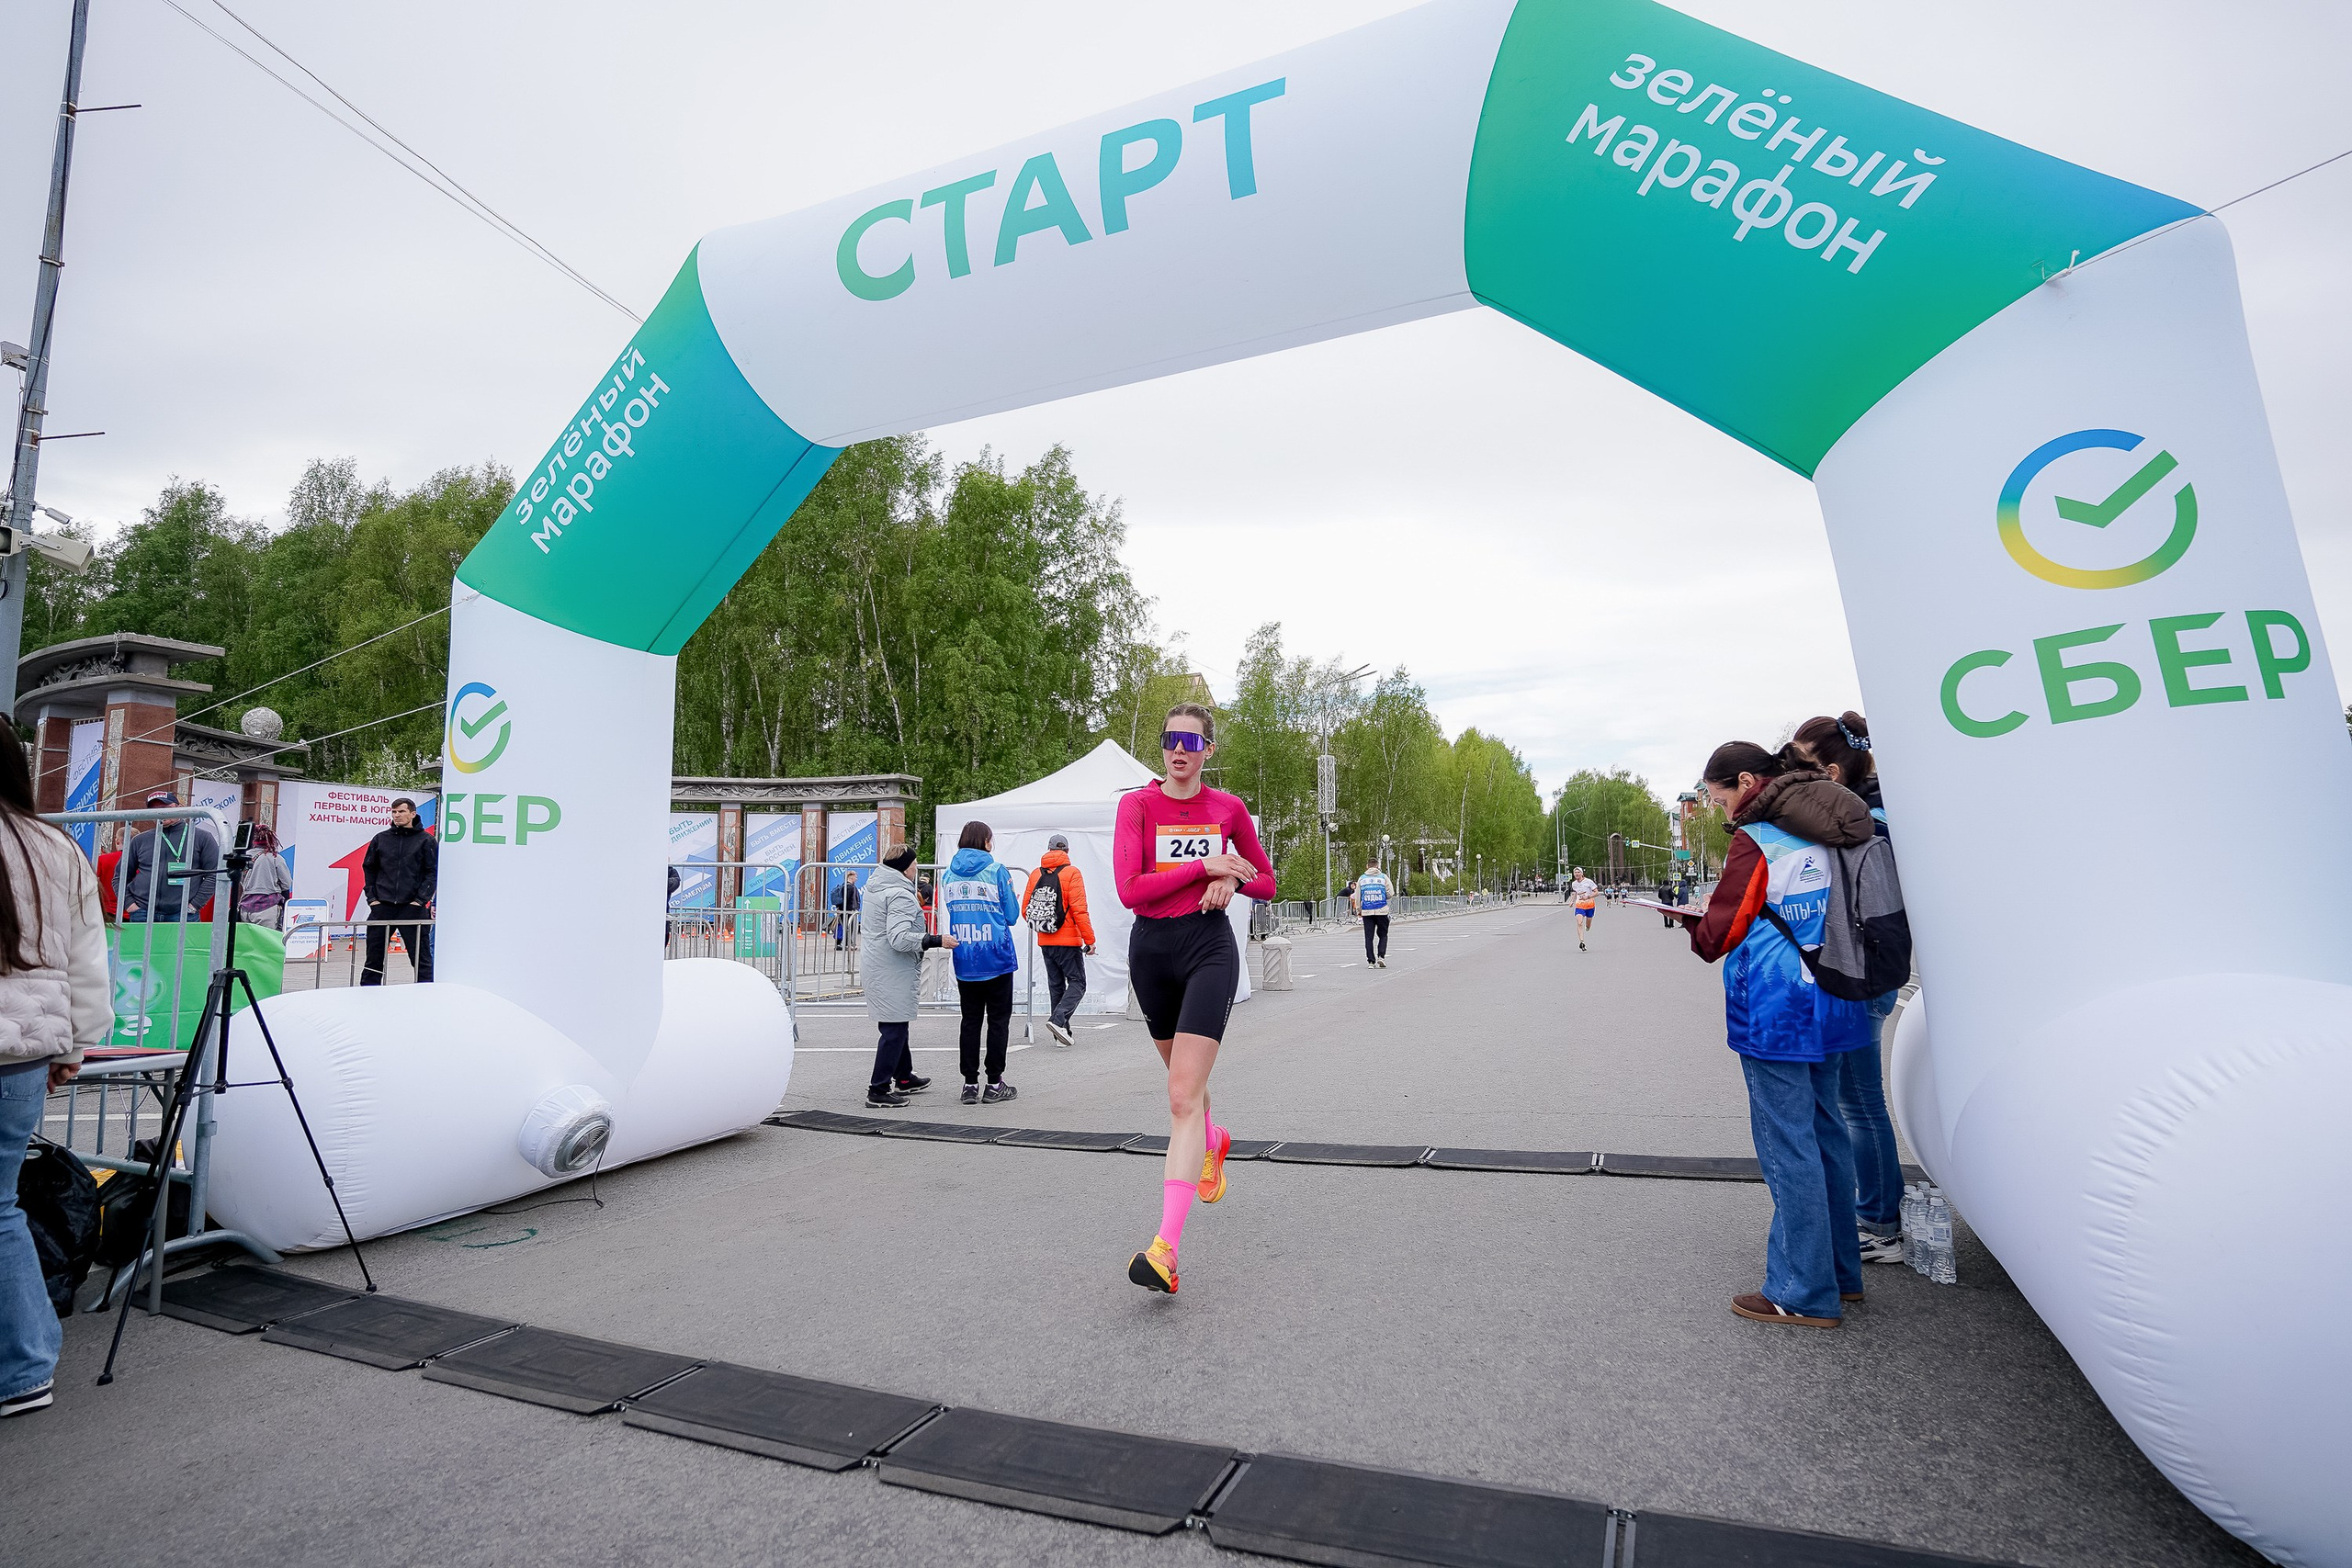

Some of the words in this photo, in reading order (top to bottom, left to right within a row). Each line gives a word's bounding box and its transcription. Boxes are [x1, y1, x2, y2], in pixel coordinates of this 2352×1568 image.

[1609, 52, 1947, 210] зелёный
[836, 76, 1287, 301] СТАРТ
[1565, 103, 1888, 275] марафон
[514, 345, 647, 525] зелёный
[530, 371, 672, 555] марафон
[1940, 609, 2312, 739] СБЕР
[73, 740, 103, 782] ФЕСТИВА
[313, 802, 357, 813] ПЕРВЫХ
[370, 807, 392, 815] ЮГР
[327, 791, 390, 804] ФЕСТИВАЛЬ
[309, 813, 392, 826] ХАНТЫ-МАНСИЙ
[439, 793, 562, 846] БЕР
[669, 819, 694, 835] БЫТЬ
[671, 817, 713, 844] ДВИЖЕНИИ
[750, 834, 770, 848] БЫТЬ
[769, 818, 797, 837] ВМЕСТЕ
[834, 833, 875, 863] ДВИЖЕНИЕ
[1170, 839, 1210, 858] 243
[1779, 897, 1826, 921] АНТЫ-М
